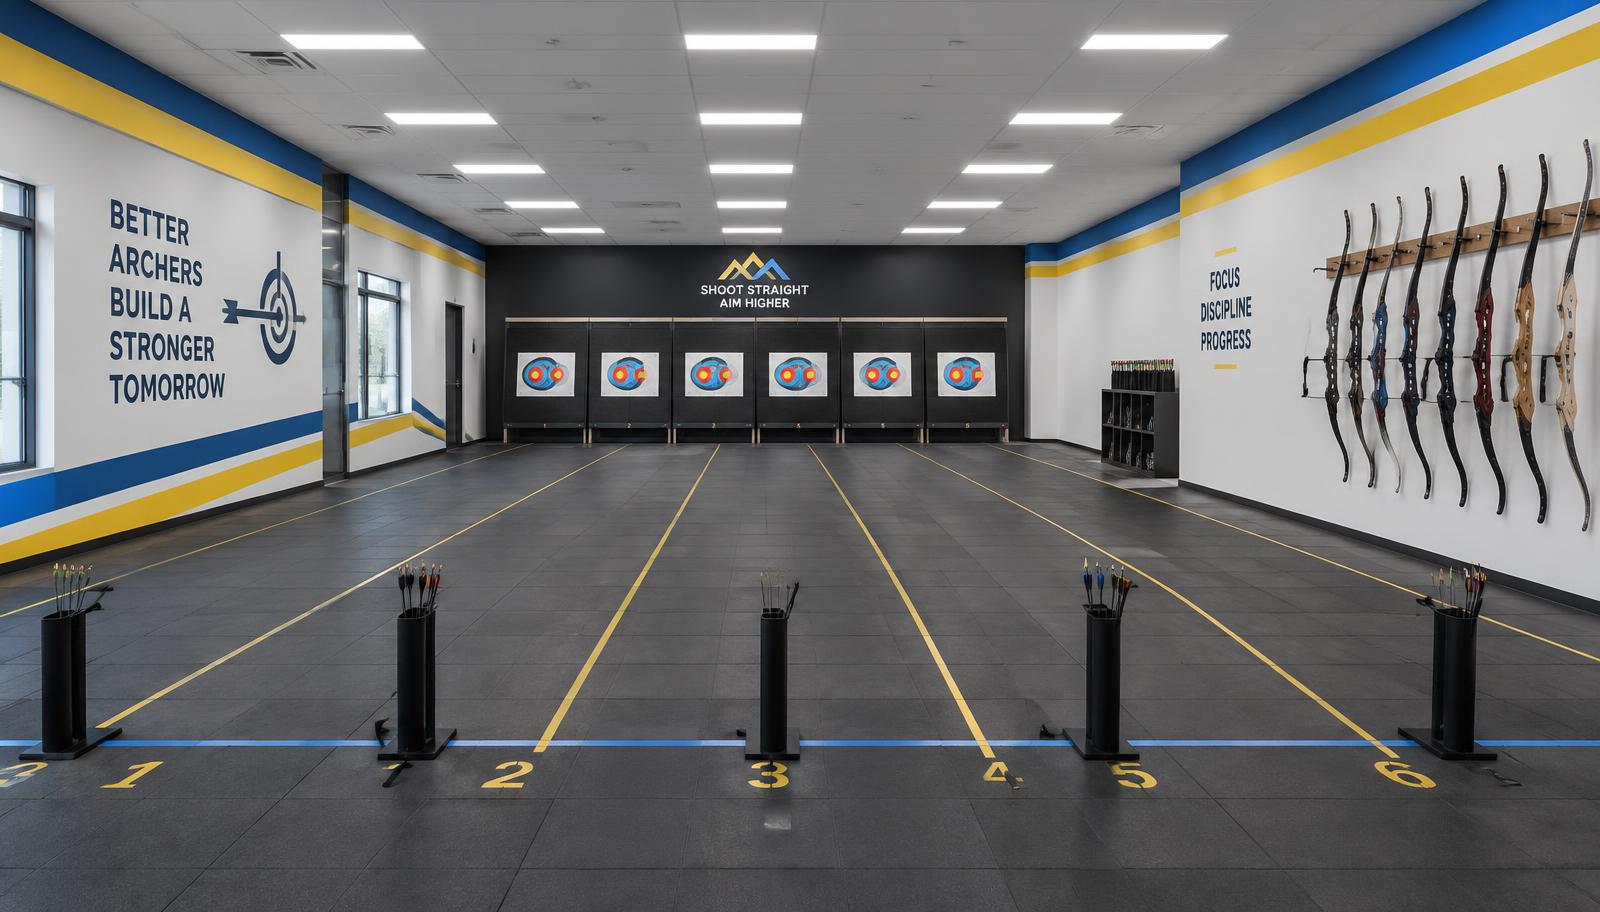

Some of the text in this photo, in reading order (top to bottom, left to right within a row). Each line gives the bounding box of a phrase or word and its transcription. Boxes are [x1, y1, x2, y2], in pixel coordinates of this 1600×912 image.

[110, 198, 190, 247] BETTER
[108, 243, 203, 287] ARCHERS
[1210, 266, 1241, 292] FOCUS
[700, 284, 810, 296] SHOOT STRAIGHT
[719, 297, 790, 309] AIM HIGHER
[110, 286, 192, 323] BUILD A
[1200, 295, 1252, 323] DISCIPLINE
[109, 330, 215, 362] STRONGER
[1200, 328, 1252, 351] PROGRESS
[108, 372, 226, 404] TOMORROW
[100, 761, 164, 788] 1
[480, 761, 534, 788] 2
[747, 761, 790, 789] 3
[1107, 761, 1158, 789] 5
[1374, 760, 1437, 789] 6
